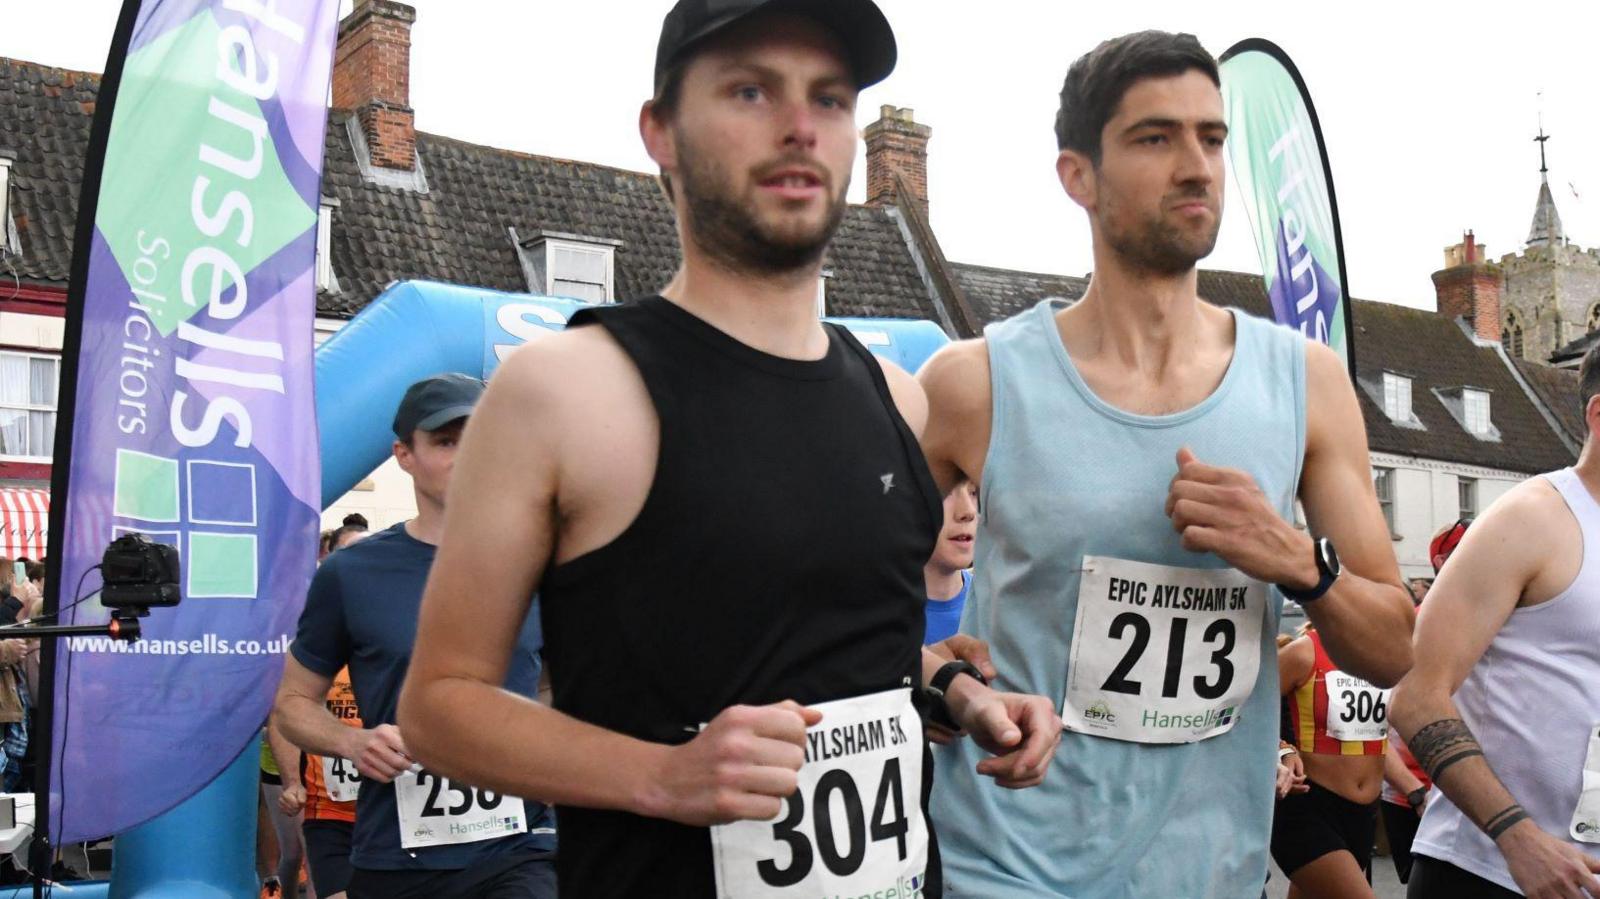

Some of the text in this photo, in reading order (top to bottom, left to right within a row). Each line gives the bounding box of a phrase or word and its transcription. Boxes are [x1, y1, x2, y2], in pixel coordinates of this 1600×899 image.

[118, 230, 170, 434] Solicitors
[1108, 577, 1248, 612] EPIC AYLSHAM 5K
[1100, 611, 1236, 700] 213
[1084, 709, 1115, 723] EPIC
[1142, 708, 1218, 729] Hansells
[1340, 690, 1386, 723] 306
[890, 714, 907, 746] 5K
[450, 815, 504, 835] Hansells
[756, 757, 909, 888] 304
[822, 875, 912, 899] nsells
